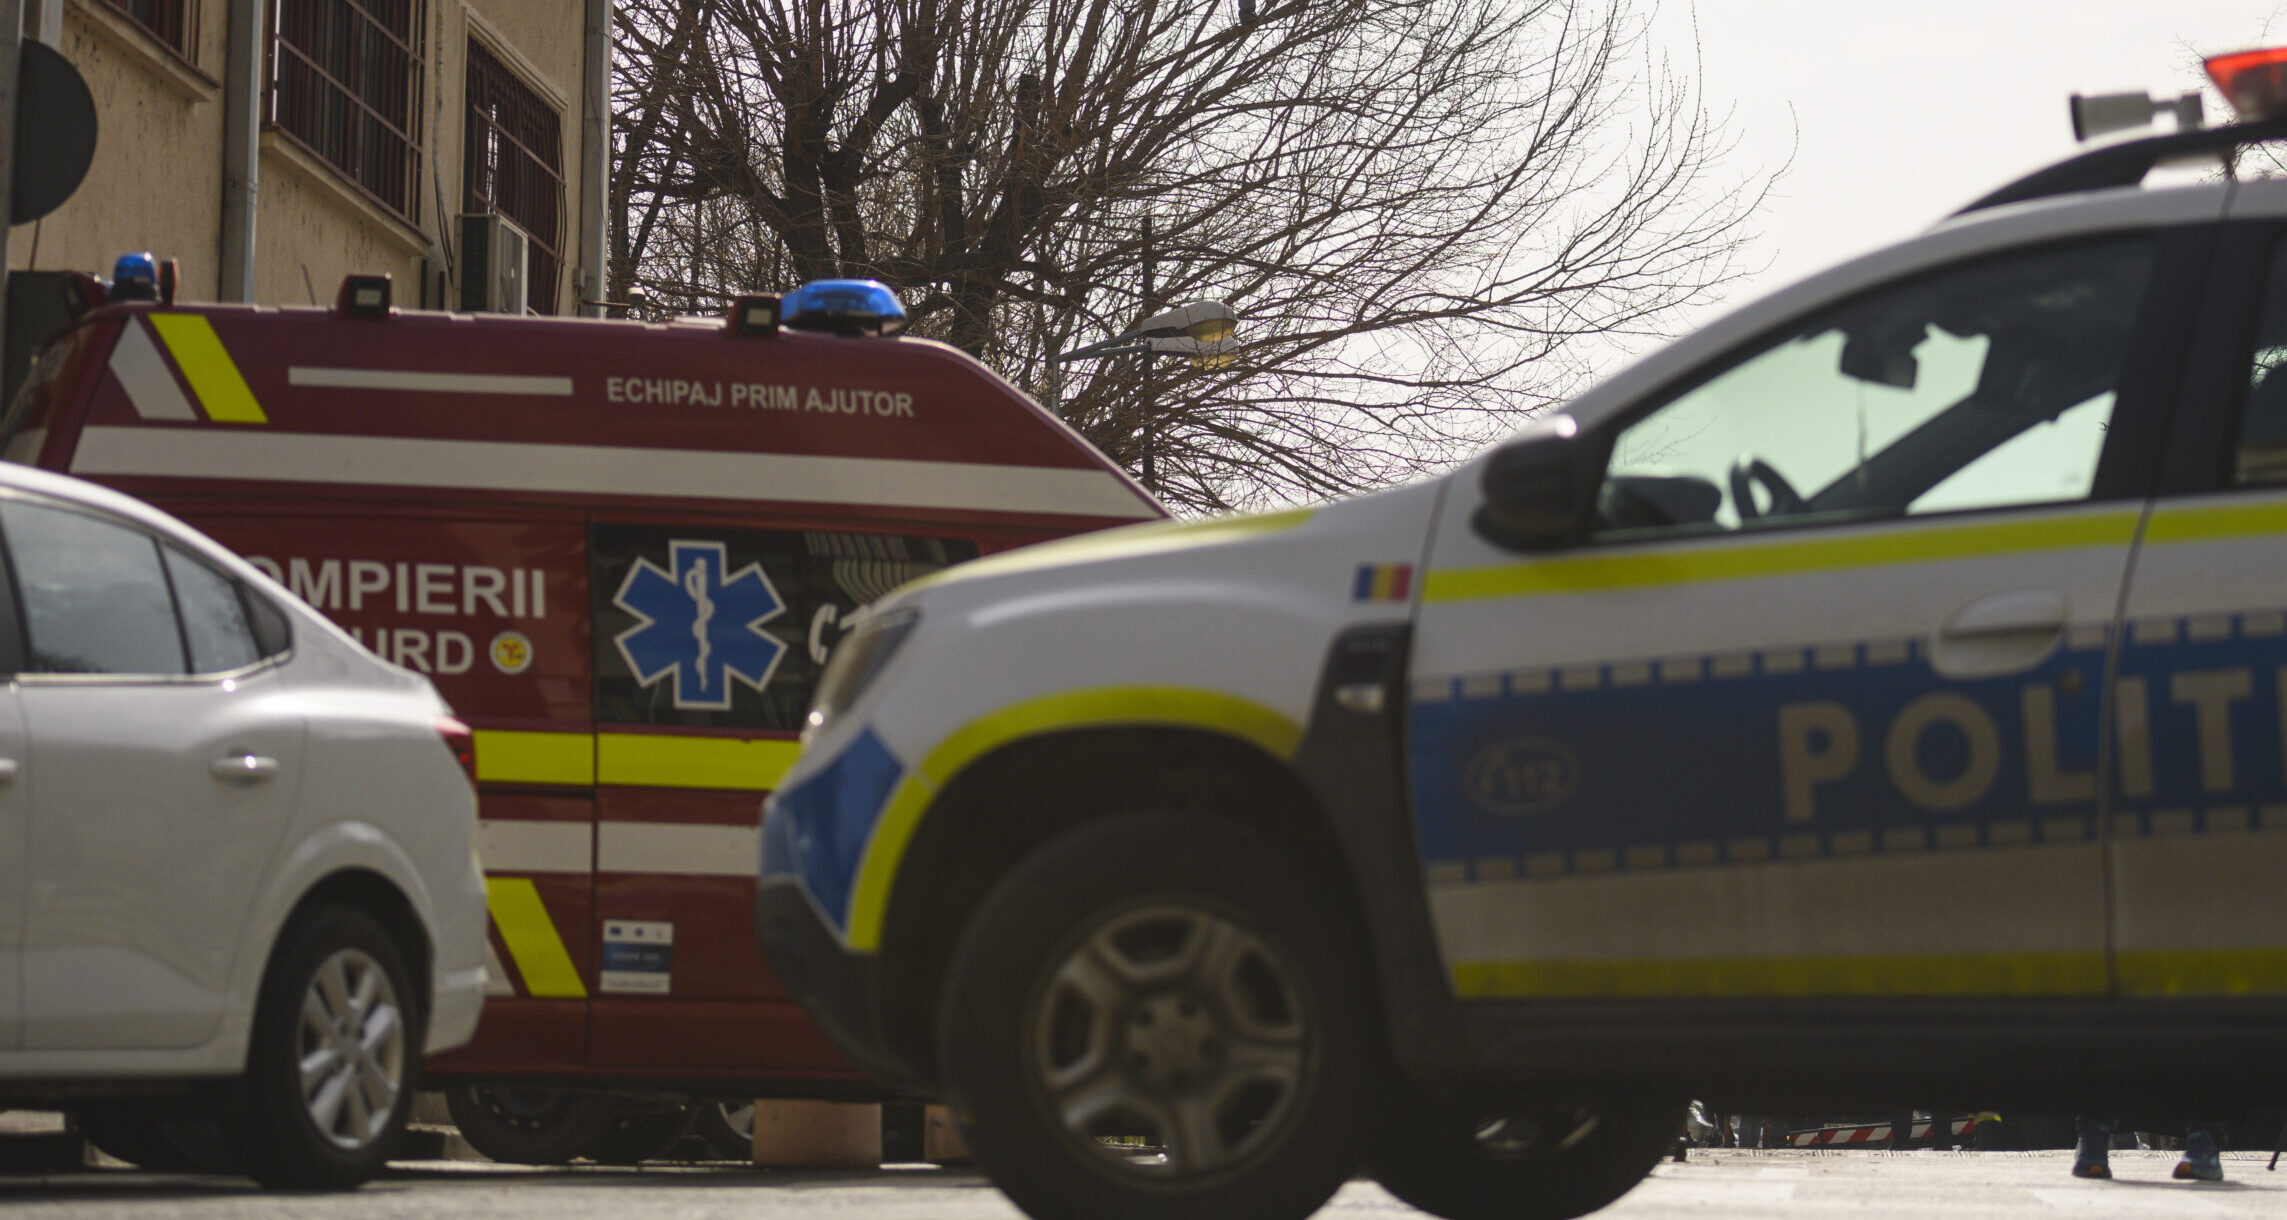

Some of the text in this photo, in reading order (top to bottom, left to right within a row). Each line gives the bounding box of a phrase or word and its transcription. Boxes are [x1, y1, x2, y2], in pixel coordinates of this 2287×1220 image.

[606, 376, 915, 418] ECHIPAJ PRIM AJUTOR
[1778, 667, 2287, 823] POLIT
